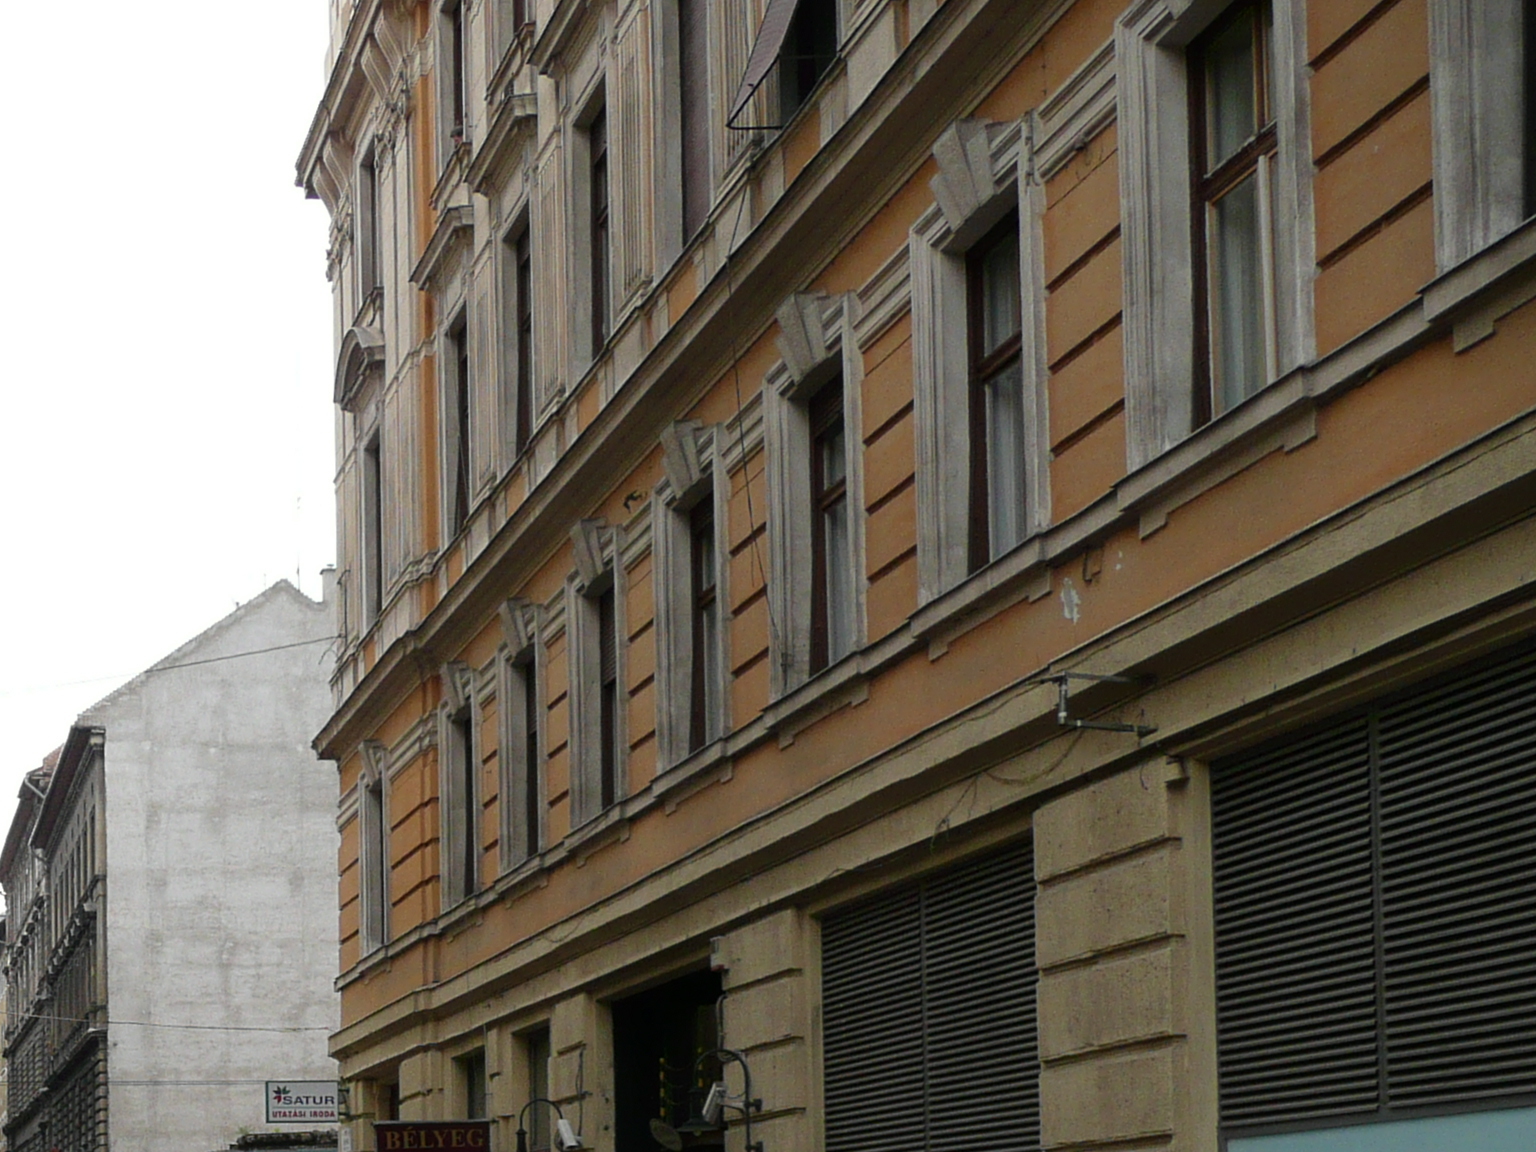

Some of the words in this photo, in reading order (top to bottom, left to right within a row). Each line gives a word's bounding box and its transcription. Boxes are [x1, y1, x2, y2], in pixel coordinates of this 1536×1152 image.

[283, 1095, 335, 1105] SATUR
[310, 1110, 335, 1118] IRODA
[385, 1126, 484, 1150] BÉLYEG
